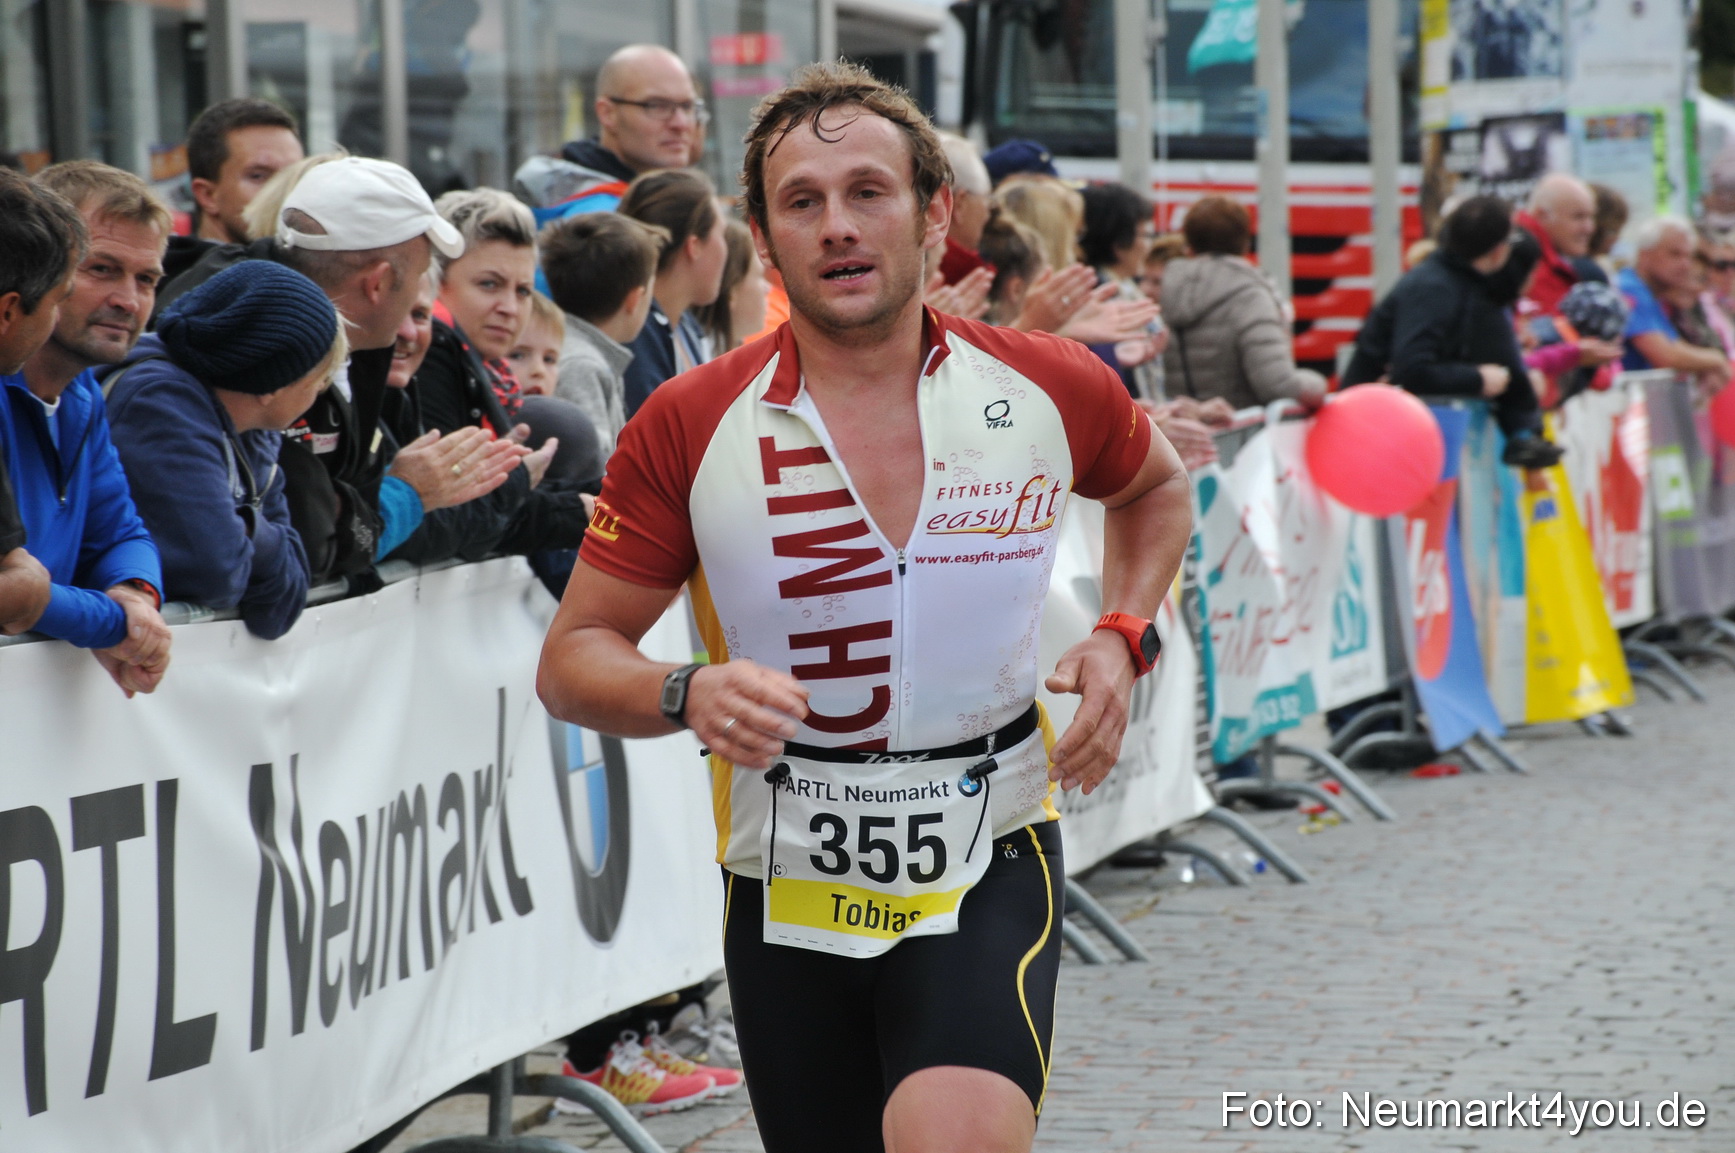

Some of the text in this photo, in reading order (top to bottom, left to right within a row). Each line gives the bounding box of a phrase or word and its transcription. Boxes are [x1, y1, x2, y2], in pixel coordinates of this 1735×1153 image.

[986, 420, 1014, 430] VIFRA
[933, 458, 946, 471] im
[937, 481, 1013, 500] FITNESS
[926, 474, 1063, 539] easyfit
[915, 544, 1044, 565] www.easyfit-parsberg.de
[776, 776, 950, 803] PARTL Neumarkt
[809, 812, 948, 884] 355
[248, 687, 534, 1053] Neumarkt
